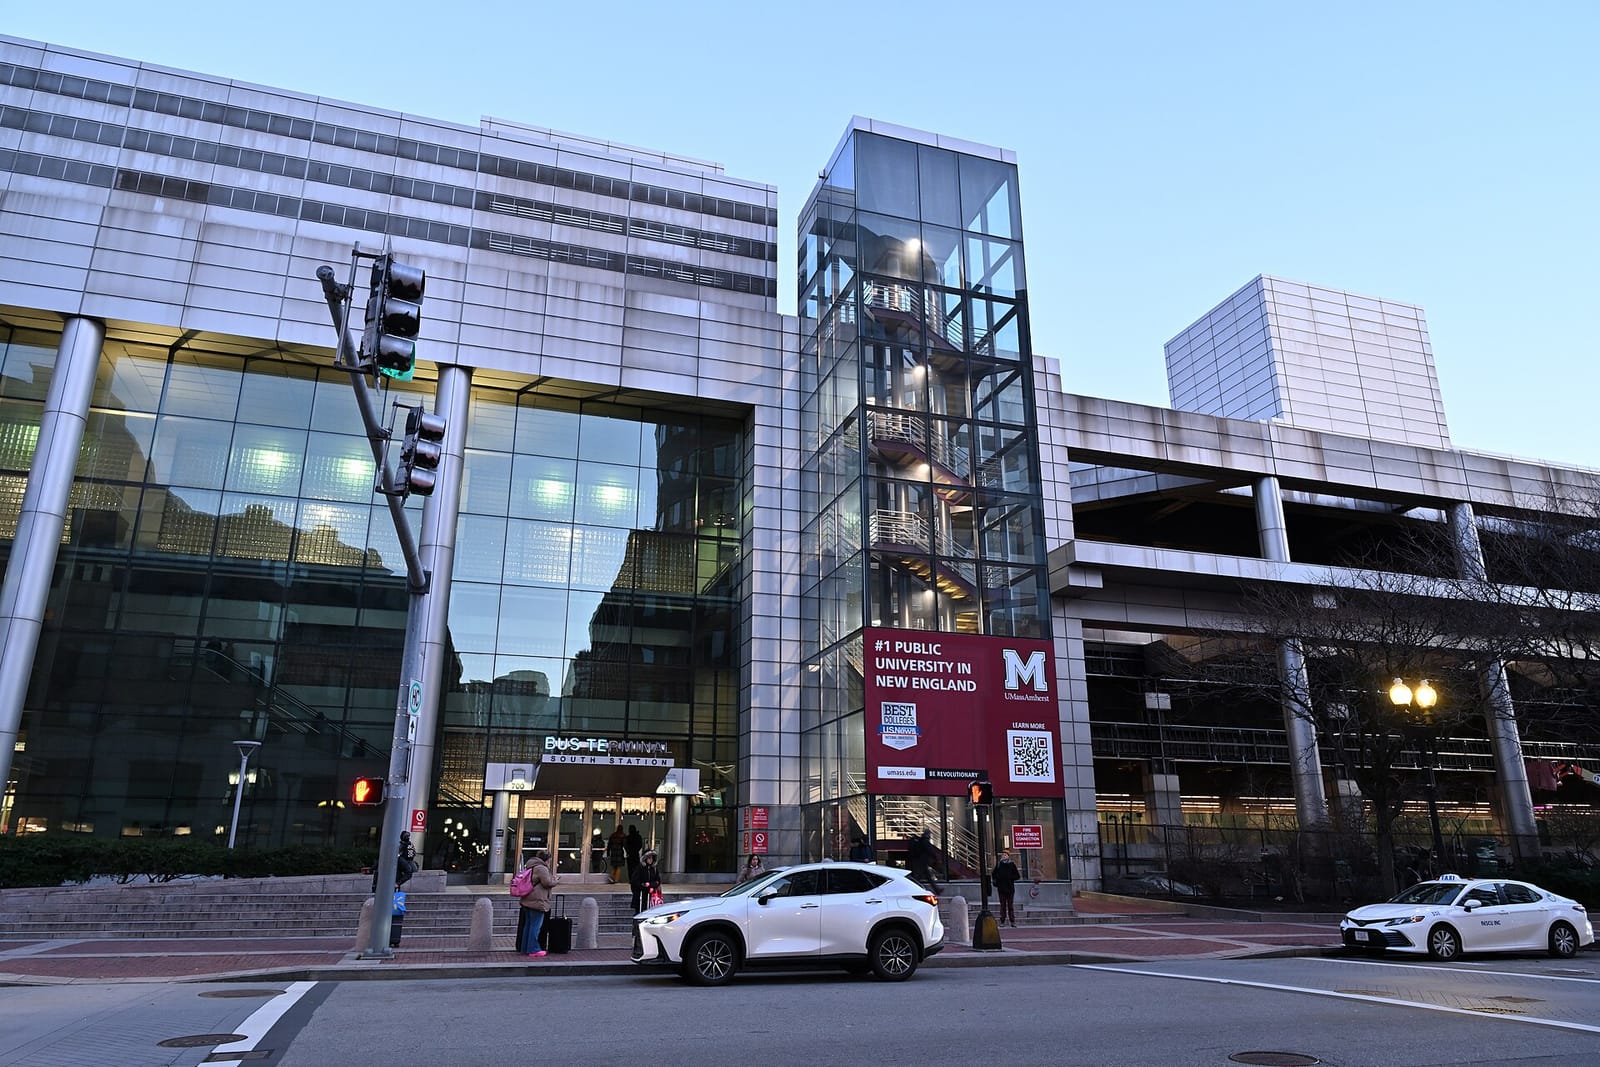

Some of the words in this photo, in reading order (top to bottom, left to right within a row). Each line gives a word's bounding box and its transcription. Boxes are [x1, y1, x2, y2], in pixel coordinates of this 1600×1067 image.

[875, 640, 890, 652] #1
[895, 641, 942, 655] PUBLIC
[875, 657, 954, 674] UNIVERSITY
[957, 663, 971, 674] IN
[1002, 648, 1048, 692] M
[876, 675, 908, 688] NEW
[912, 677, 977, 692] ENGLAND
[884, 704, 914, 716] BEST
[884, 716, 915, 725] COLLEGES
[1030, 722, 1046, 730] MORE
[545, 735, 580, 751] BUS
[586, 738, 673, 753] TERMINAL
[550, 755, 596, 763] SOUTH
[609, 757, 667, 766] STATION
[511, 782, 525, 790] 700
